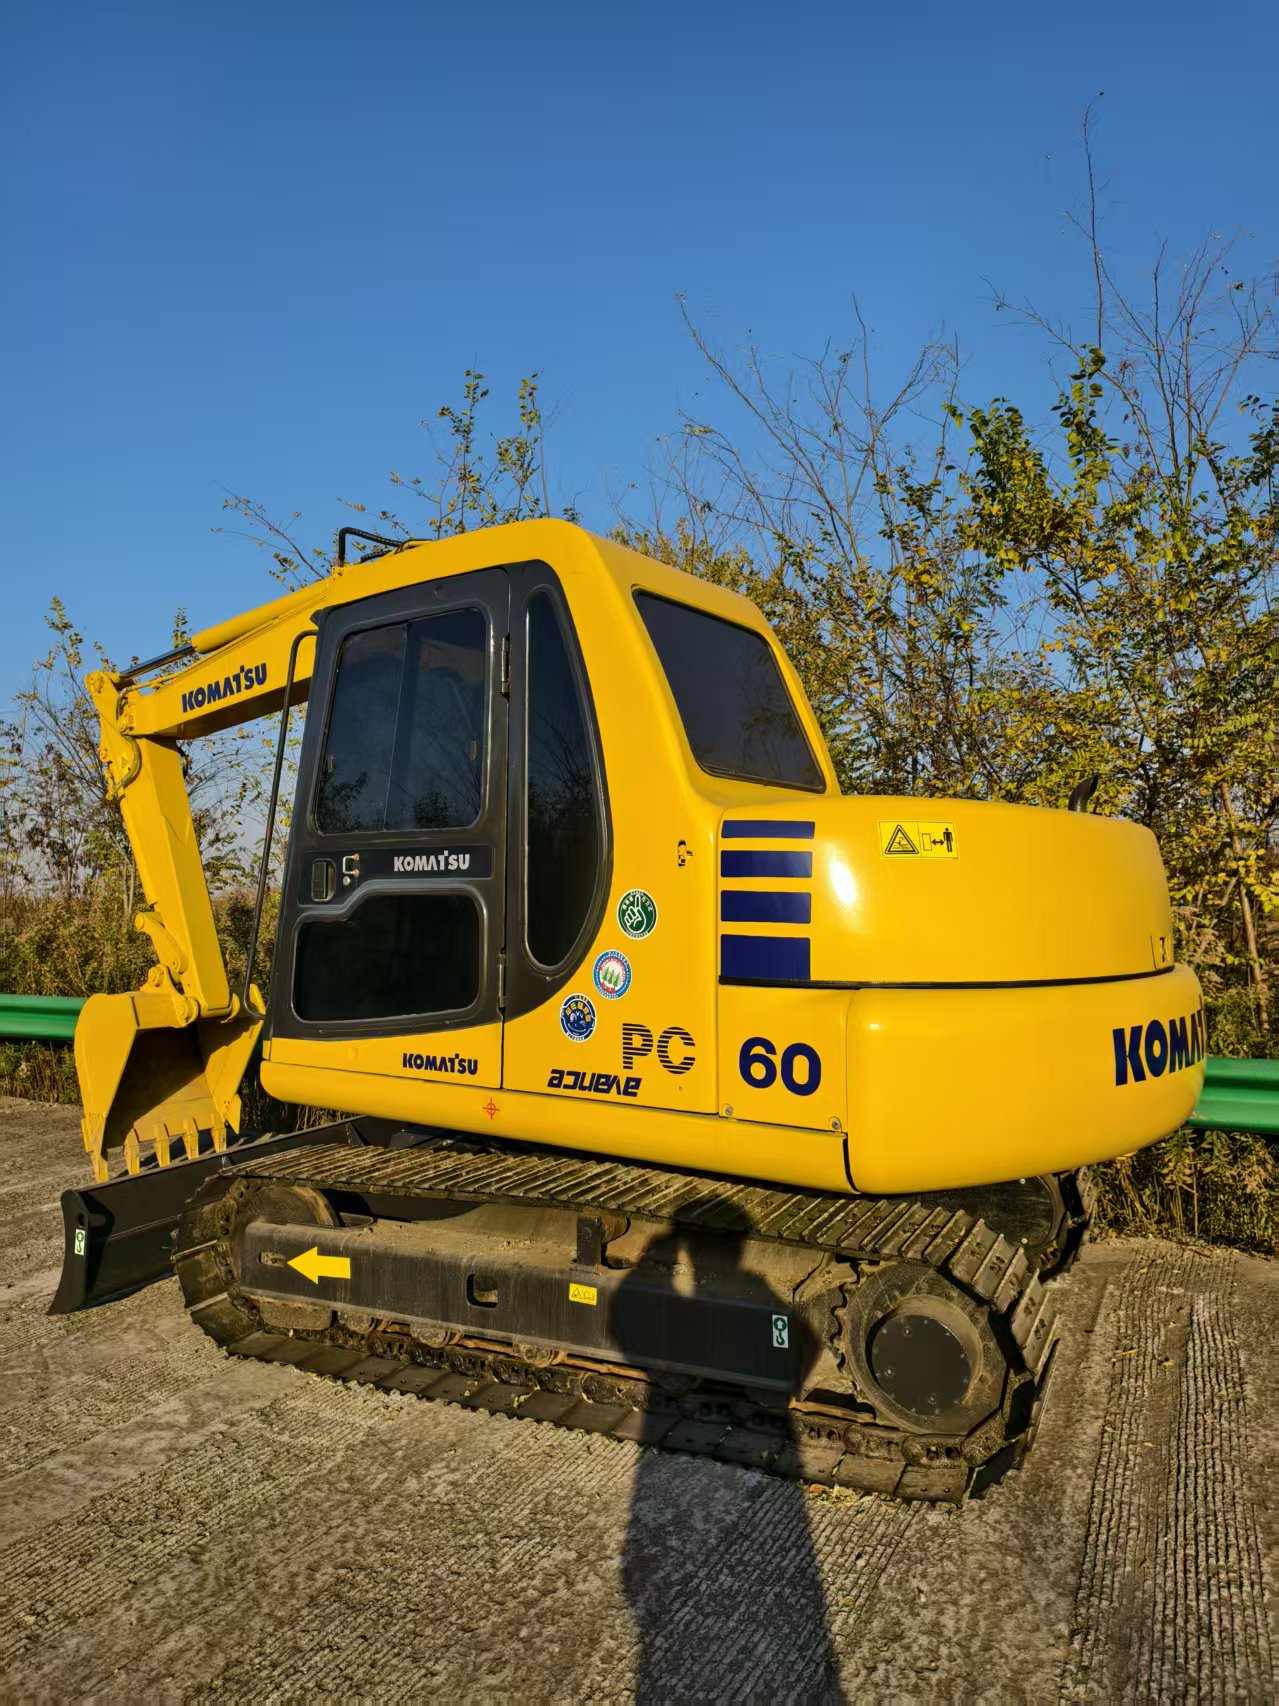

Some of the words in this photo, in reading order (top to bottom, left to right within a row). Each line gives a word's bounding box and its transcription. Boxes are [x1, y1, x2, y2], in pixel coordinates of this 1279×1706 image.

[181, 662, 268, 713] KOMATSU
[393, 850, 470, 872] KOMATSU
[402, 1053, 479, 1075] KOMATSU
[622, 1023, 696, 1075] PC
[739, 1037, 822, 1097] 60
